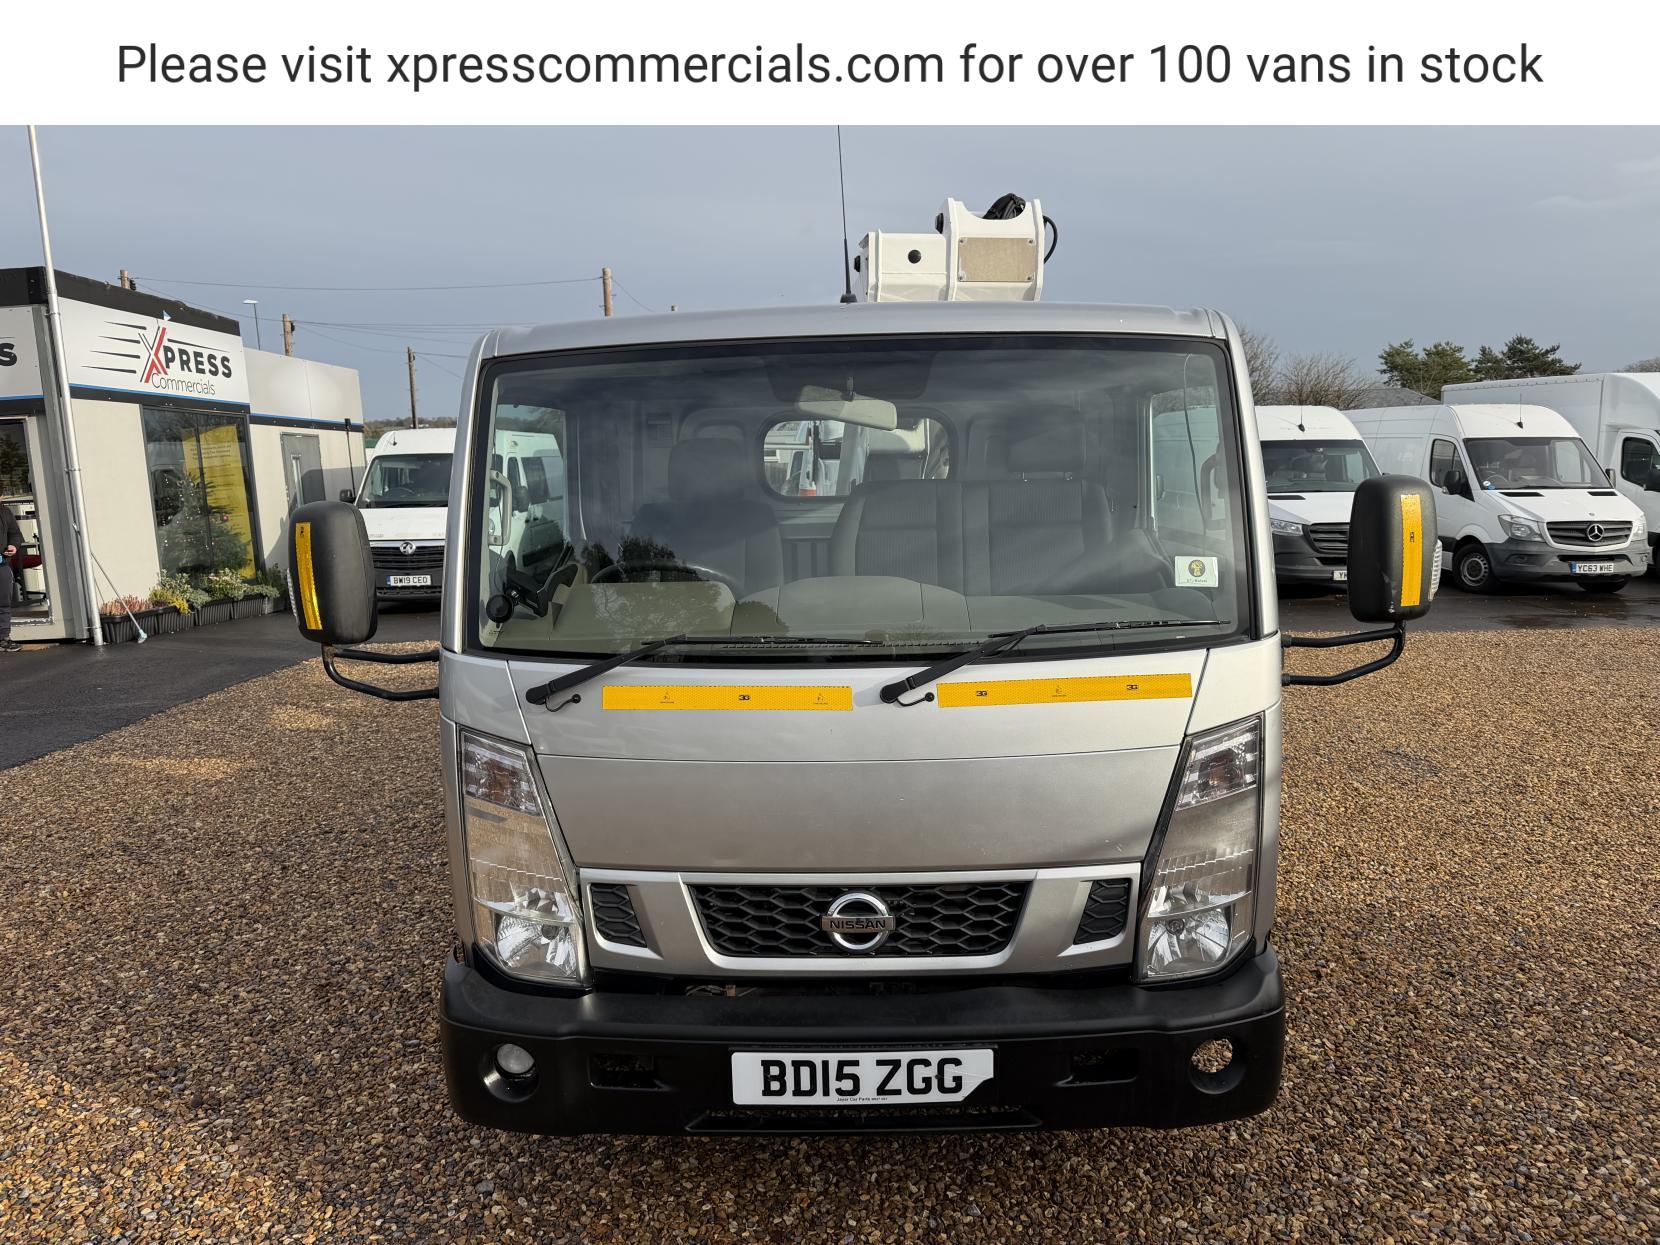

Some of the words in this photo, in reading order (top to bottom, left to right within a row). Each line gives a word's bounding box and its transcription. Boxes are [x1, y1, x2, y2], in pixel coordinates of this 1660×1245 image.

[152, 373, 216, 395] Commercials
[1578, 564, 1598, 572] YC63
[393, 576, 411, 584] BW19
[830, 920, 886, 929] NISSAN
[760, 1059, 861, 1097] BD15
[876, 1057, 963, 1096] ZGG
